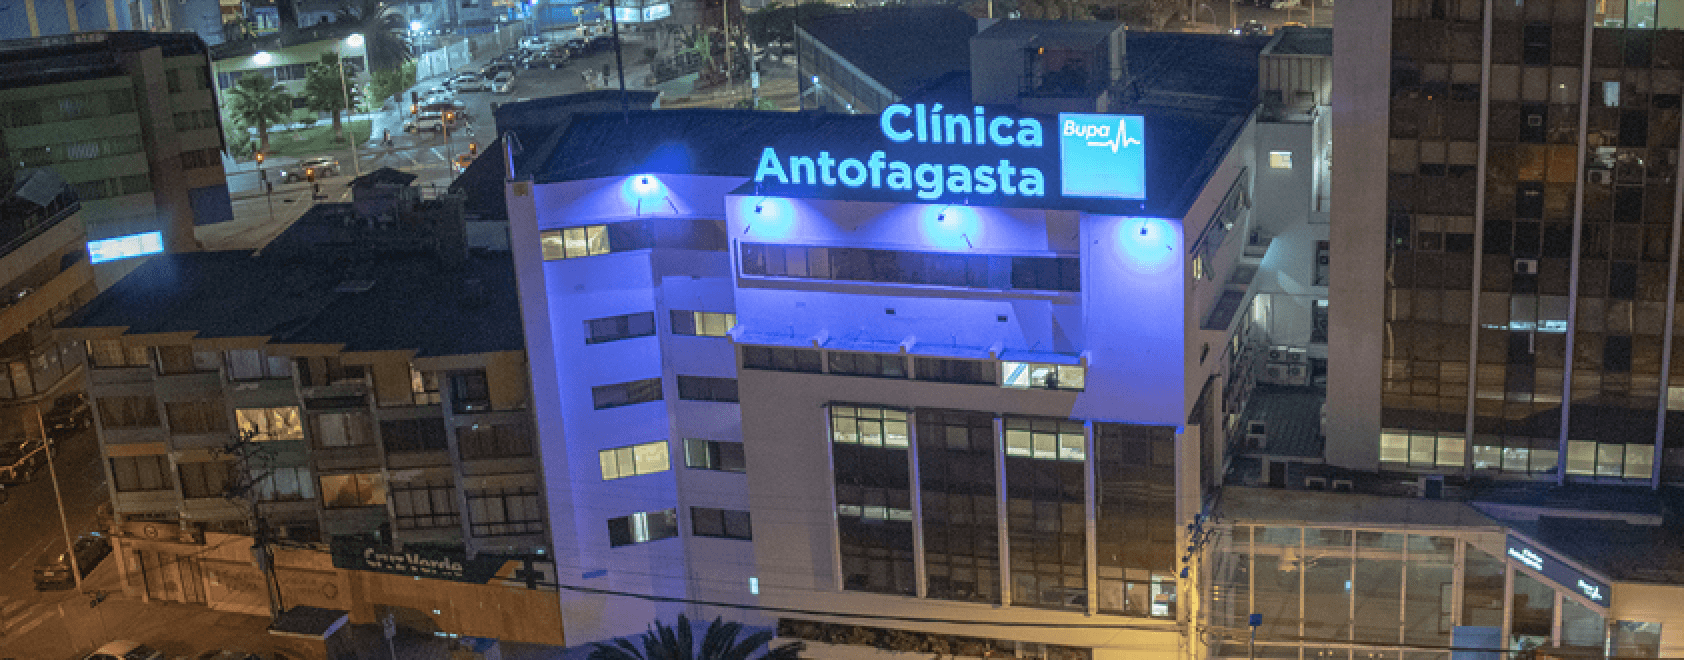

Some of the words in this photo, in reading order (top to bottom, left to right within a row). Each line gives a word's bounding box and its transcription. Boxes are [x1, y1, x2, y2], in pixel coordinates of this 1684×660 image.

[880, 102, 1044, 147] Clínica
[1063, 119, 1111, 139] Bupa
[755, 147, 1045, 199] Antofagasta
